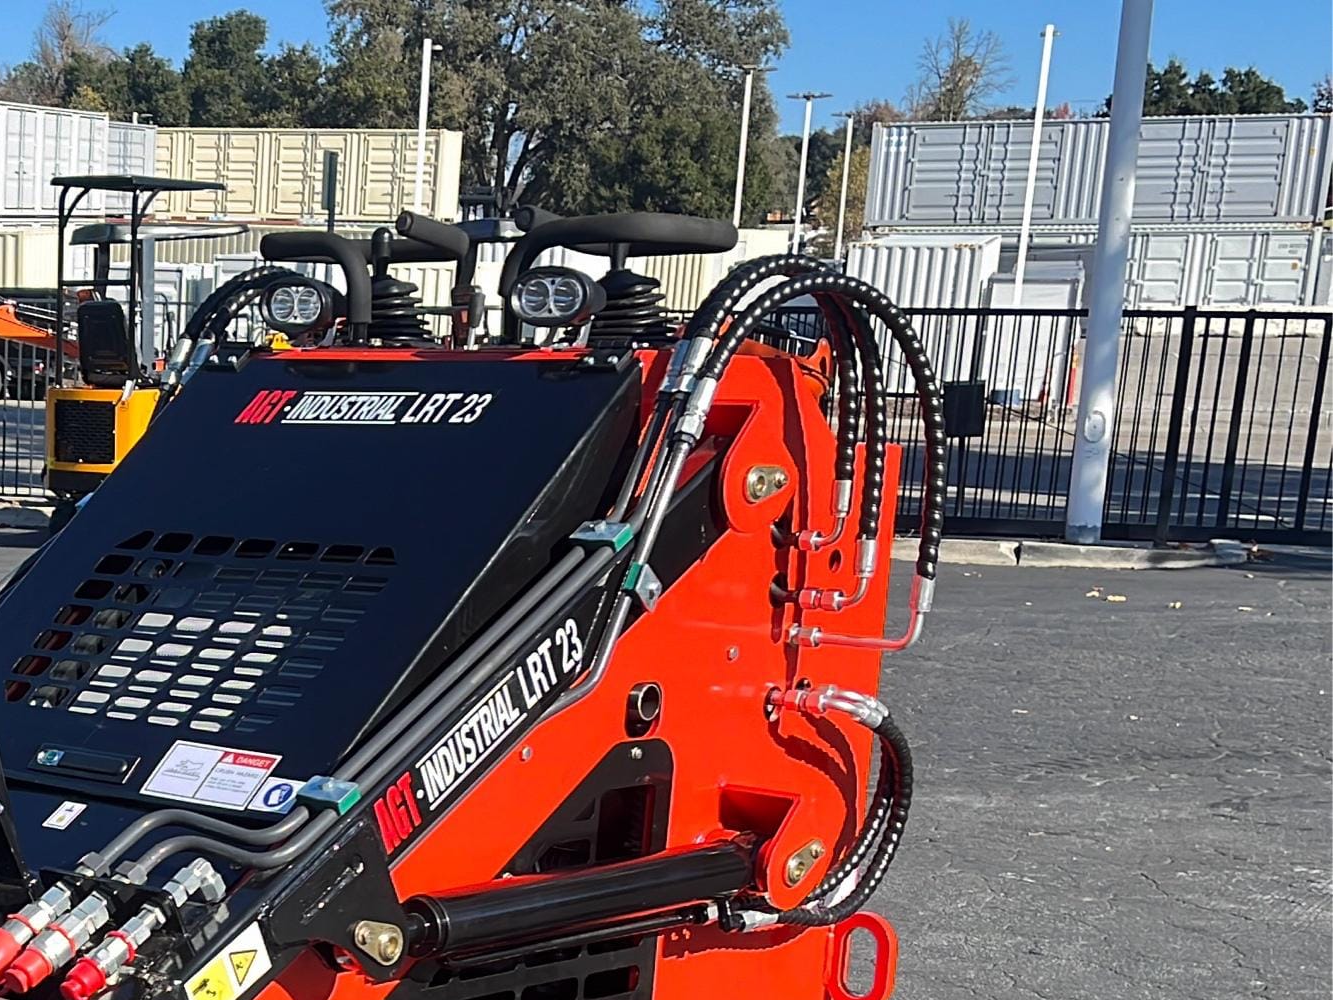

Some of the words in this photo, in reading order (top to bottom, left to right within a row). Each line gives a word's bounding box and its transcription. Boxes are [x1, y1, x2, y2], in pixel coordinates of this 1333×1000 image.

[234, 390, 298, 424] AGT
[400, 393, 464, 423] LRT
[448, 393, 492, 423] 23
[373, 771, 422, 855] AGT
[517, 638, 558, 709] LRT
[556, 618, 583, 673] 23
